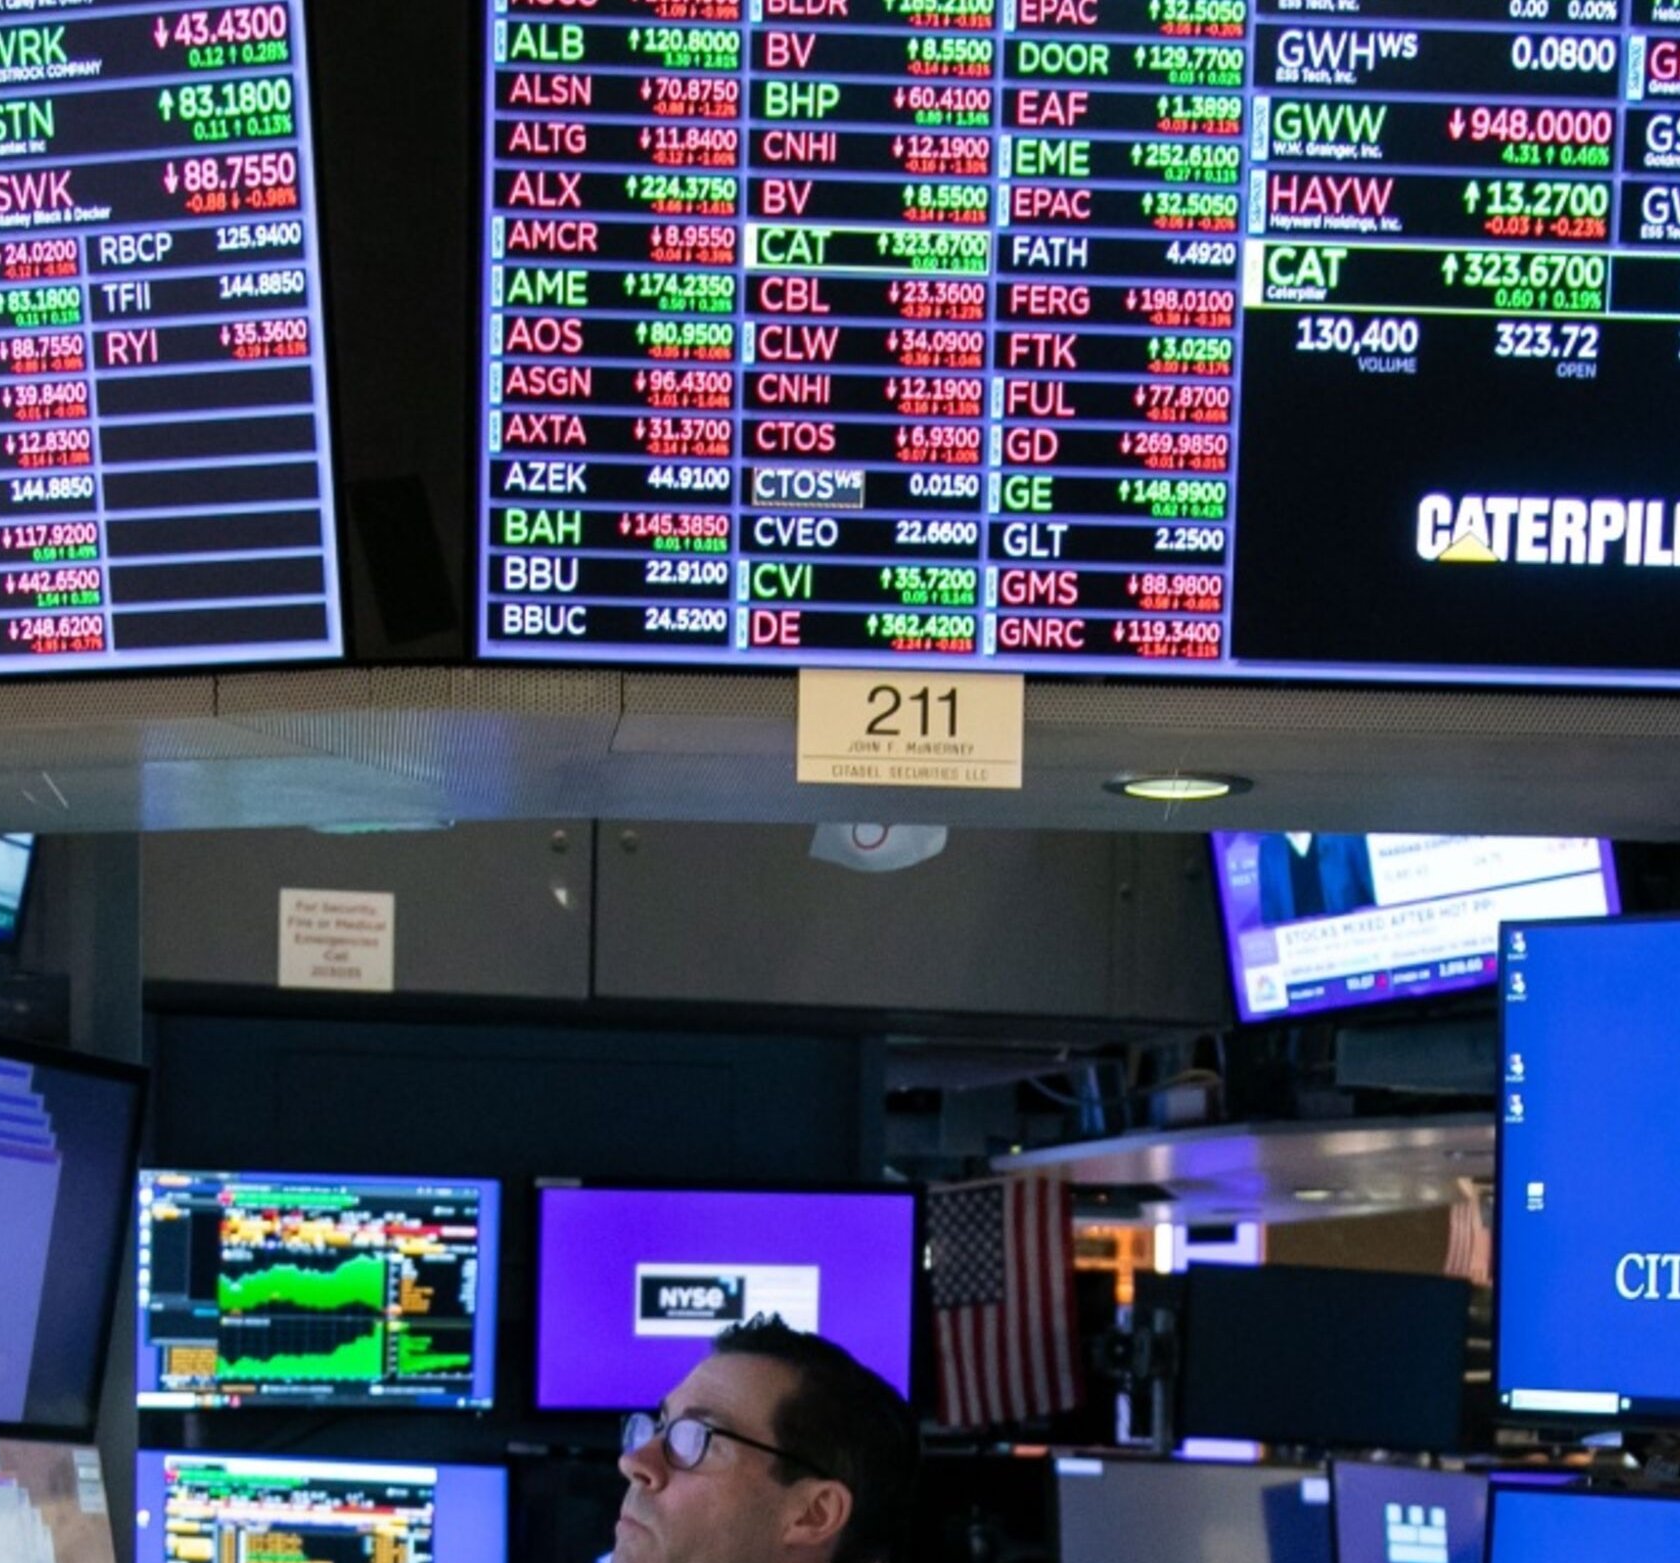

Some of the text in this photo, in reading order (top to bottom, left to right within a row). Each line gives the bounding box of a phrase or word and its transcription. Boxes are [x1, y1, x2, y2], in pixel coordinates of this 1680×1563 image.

[174, 6, 287, 45] 43.4300
[512, 28, 584, 61] ALB
[1019, 42, 1109, 74] DOOR
[180, 80, 291, 116] 83.1800
[766, 84, 839, 119] BHP
[1275, 104, 1611, 142] GWW 948.0000
[1018, 141, 1089, 174] EME
[1271, 178, 1608, 216] HAYW 13.2700
[100, 221, 301, 264] RBCP 125.9400
[1269, 248, 1346, 286] CAT
[1464, 252, 1603, 288] 323.6700
[509, 270, 588, 304] AME
[1296, 319, 1418, 354] 130,400
[1495, 325, 1598, 358] 323.72
[1358, 356, 1416, 374] VOLUME
[1557, 362, 1596, 379] OPEN
[504, 464, 730, 492] AZEK 44.9100
[754, 519, 838, 546] CVEO
[1003, 525, 1224, 556] GLT 2.2500
[505, 558, 728, 590] BBU 22.9100
[1001, 619, 1084, 648] GNRC
[865, 684, 957, 737] 211
[849, 741, 880, 753] JOHN
[832, 765, 989, 781] CITADEL SECURITIES LLC
[1285, 928, 1337, 945] STOCKS
[1343, 918, 1384, 935] MIXED
[1391, 912, 1434, 929] AFTER
[1439, 904, 1468, 919] HOT
